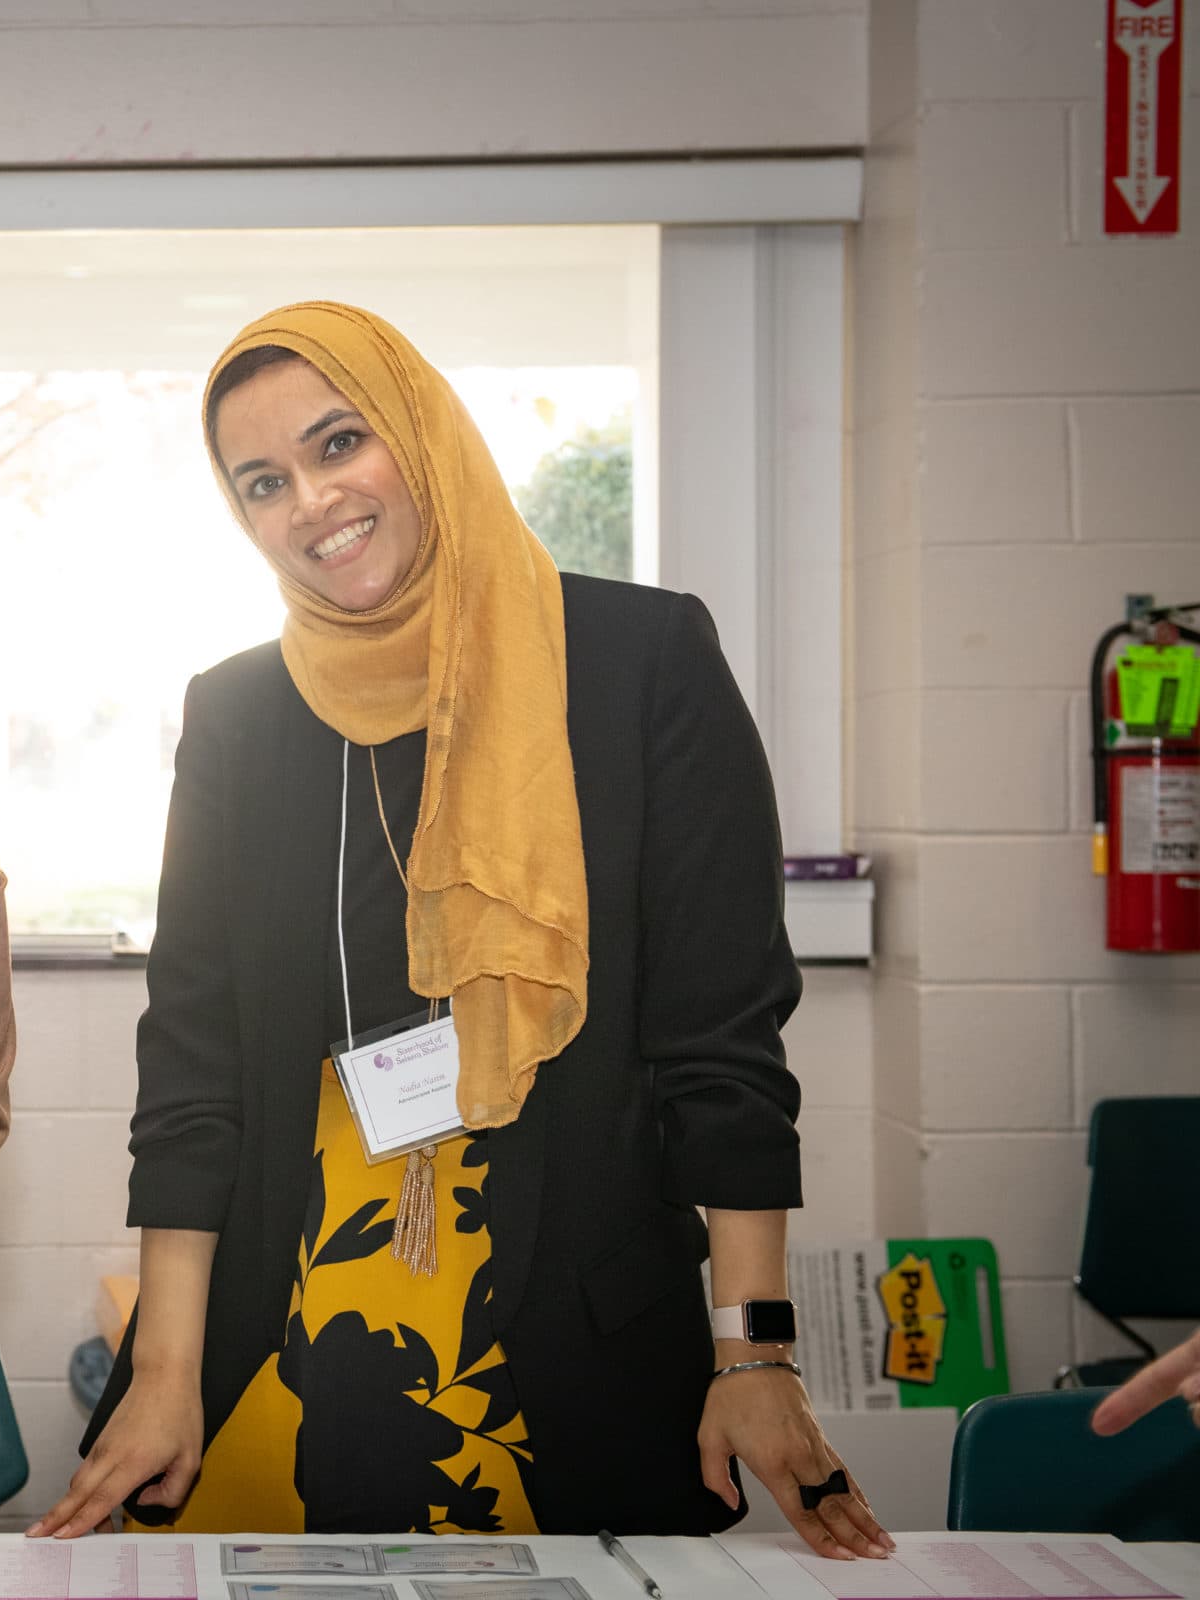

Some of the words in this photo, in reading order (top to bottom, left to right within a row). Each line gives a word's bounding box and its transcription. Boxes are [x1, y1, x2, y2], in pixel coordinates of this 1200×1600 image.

[1117, 16, 1173, 38] FIRE
[1136, 45, 1149, 209] EXTINGUISHER
[396, 1037, 434, 1056] Sisterhood
[421, 1043, 449, 1056] Shalom
[899, 1269, 930, 1372] Post-it
